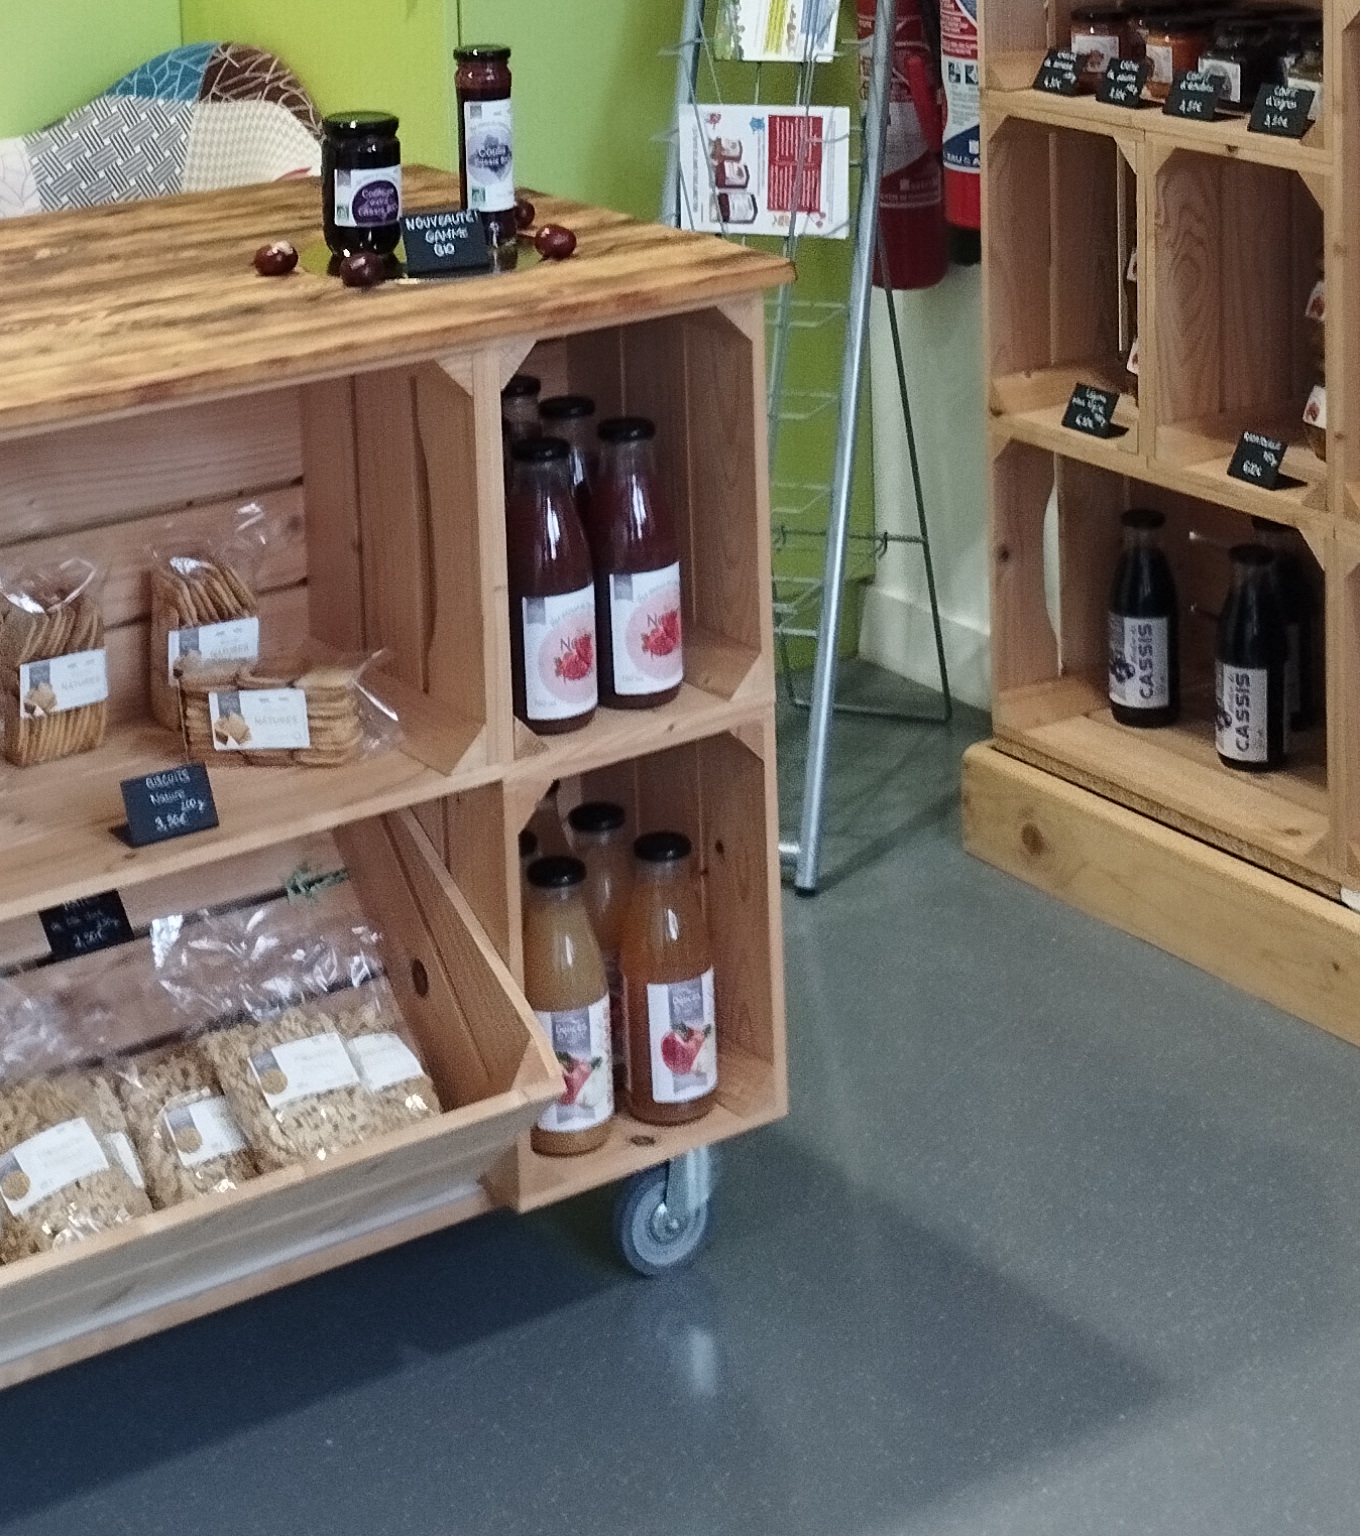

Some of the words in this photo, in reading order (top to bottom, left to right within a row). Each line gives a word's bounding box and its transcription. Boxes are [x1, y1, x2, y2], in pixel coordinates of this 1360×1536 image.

[425, 227, 469, 244] GAMME
[433, 243, 456, 258] BIO
[1138, 622, 1154, 700] CASSIS
[1235, 672, 1251, 753] CASSIS
